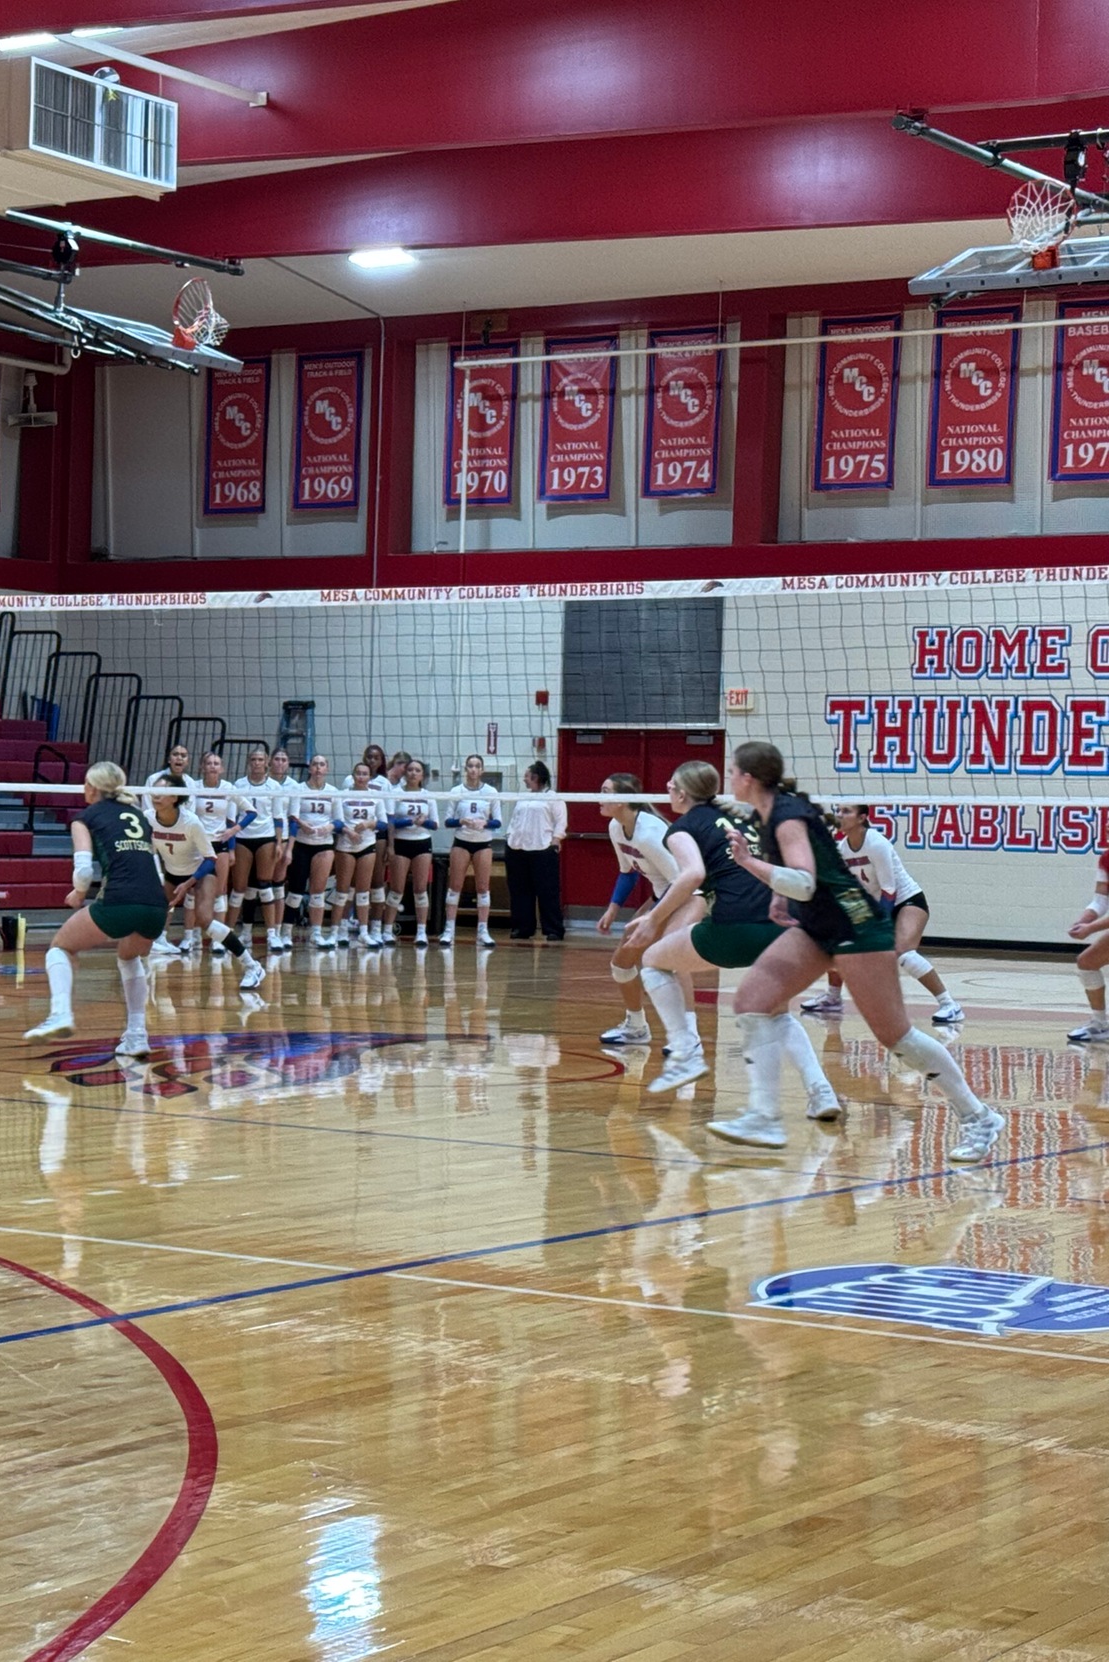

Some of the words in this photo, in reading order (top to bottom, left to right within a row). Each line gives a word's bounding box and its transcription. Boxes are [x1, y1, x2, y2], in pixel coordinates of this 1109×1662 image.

[1068, 326, 1109, 336] BASEB
[304, 362, 323, 370] MEN'S
[324, 360, 356, 369] OUTDOOR
[833, 353, 874, 374] COMMUNITY
[949, 348, 991, 368] COMMUNITY
[307, 370, 326, 378] TRACK
[334, 369, 352, 377] FIELD
[959, 362, 992, 396] MCC
[843, 367, 875, 403] MCC
[564, 386, 592, 418] MCC
[669, 381, 699, 414] MCC
[225, 406, 251, 436] MCC
[315, 400, 341, 431] MCC
[1070, 417, 1109, 427] NATION
[831, 428, 882, 438] NATIONAL
[946, 424, 999, 434] NATIONAL
[555, 441, 600, 450] NATIONAL
[660, 436, 708, 446] NATIONAL
[826, 439, 886, 450] CHAMPIONS
[941, 436, 1003, 446] CHAMPIONS
[306, 454, 349, 463] NATIONAL
[550, 453, 604, 462] CHAMPIONS
[655, 448, 711, 458] CHAMPIONS
[940, 448, 1003, 474] 1980
[1064, 442, 1109, 469] 197
[217, 459, 257, 467] NATIONAL
[302, 465, 353, 475] CHAMPIONS
[453, 458, 507, 468] CAMPIONS
[825, 454, 885, 480] 1975
[212, 469, 261, 479] CHAMPIONS
[550, 466, 603, 490] 1973
[655, 460, 710, 486] 1974
[302, 476, 353, 500] 1969
[455, 470, 507, 493] 1970
[213, 481, 261, 504] 1968
[781, 576, 829, 590] MESA
[835, 573, 942, 589] COMMUNITY
[948, 569, 1026, 585] COLLEGE
[1032, 566, 1109, 581] THUNDE
[50, 595, 104, 607] COLLEGE
[108, 592, 207, 606] THUNDERBIRDS
[320, 589, 360, 602] MESA
[364, 587, 453, 601] COMMUNITY
[458, 586, 521, 600] COLLEGE
[526, 582, 645, 598] THUNDERBIRDS
[912, 624, 1072, 680] HOME
[1087, 624, 1109, 680] O
[728, 689, 749, 706] EXIT
[825, 694, 1109, 777] THUNDE
[205, 802, 213, 813] 2
[311, 802, 325, 814] 13
[352, 808, 368, 819] 23
[408, 805, 421, 816] 21
[119, 812, 145, 839] 3
[868, 804, 1109, 854] STABLIS
[165, 843, 174, 856] 7
